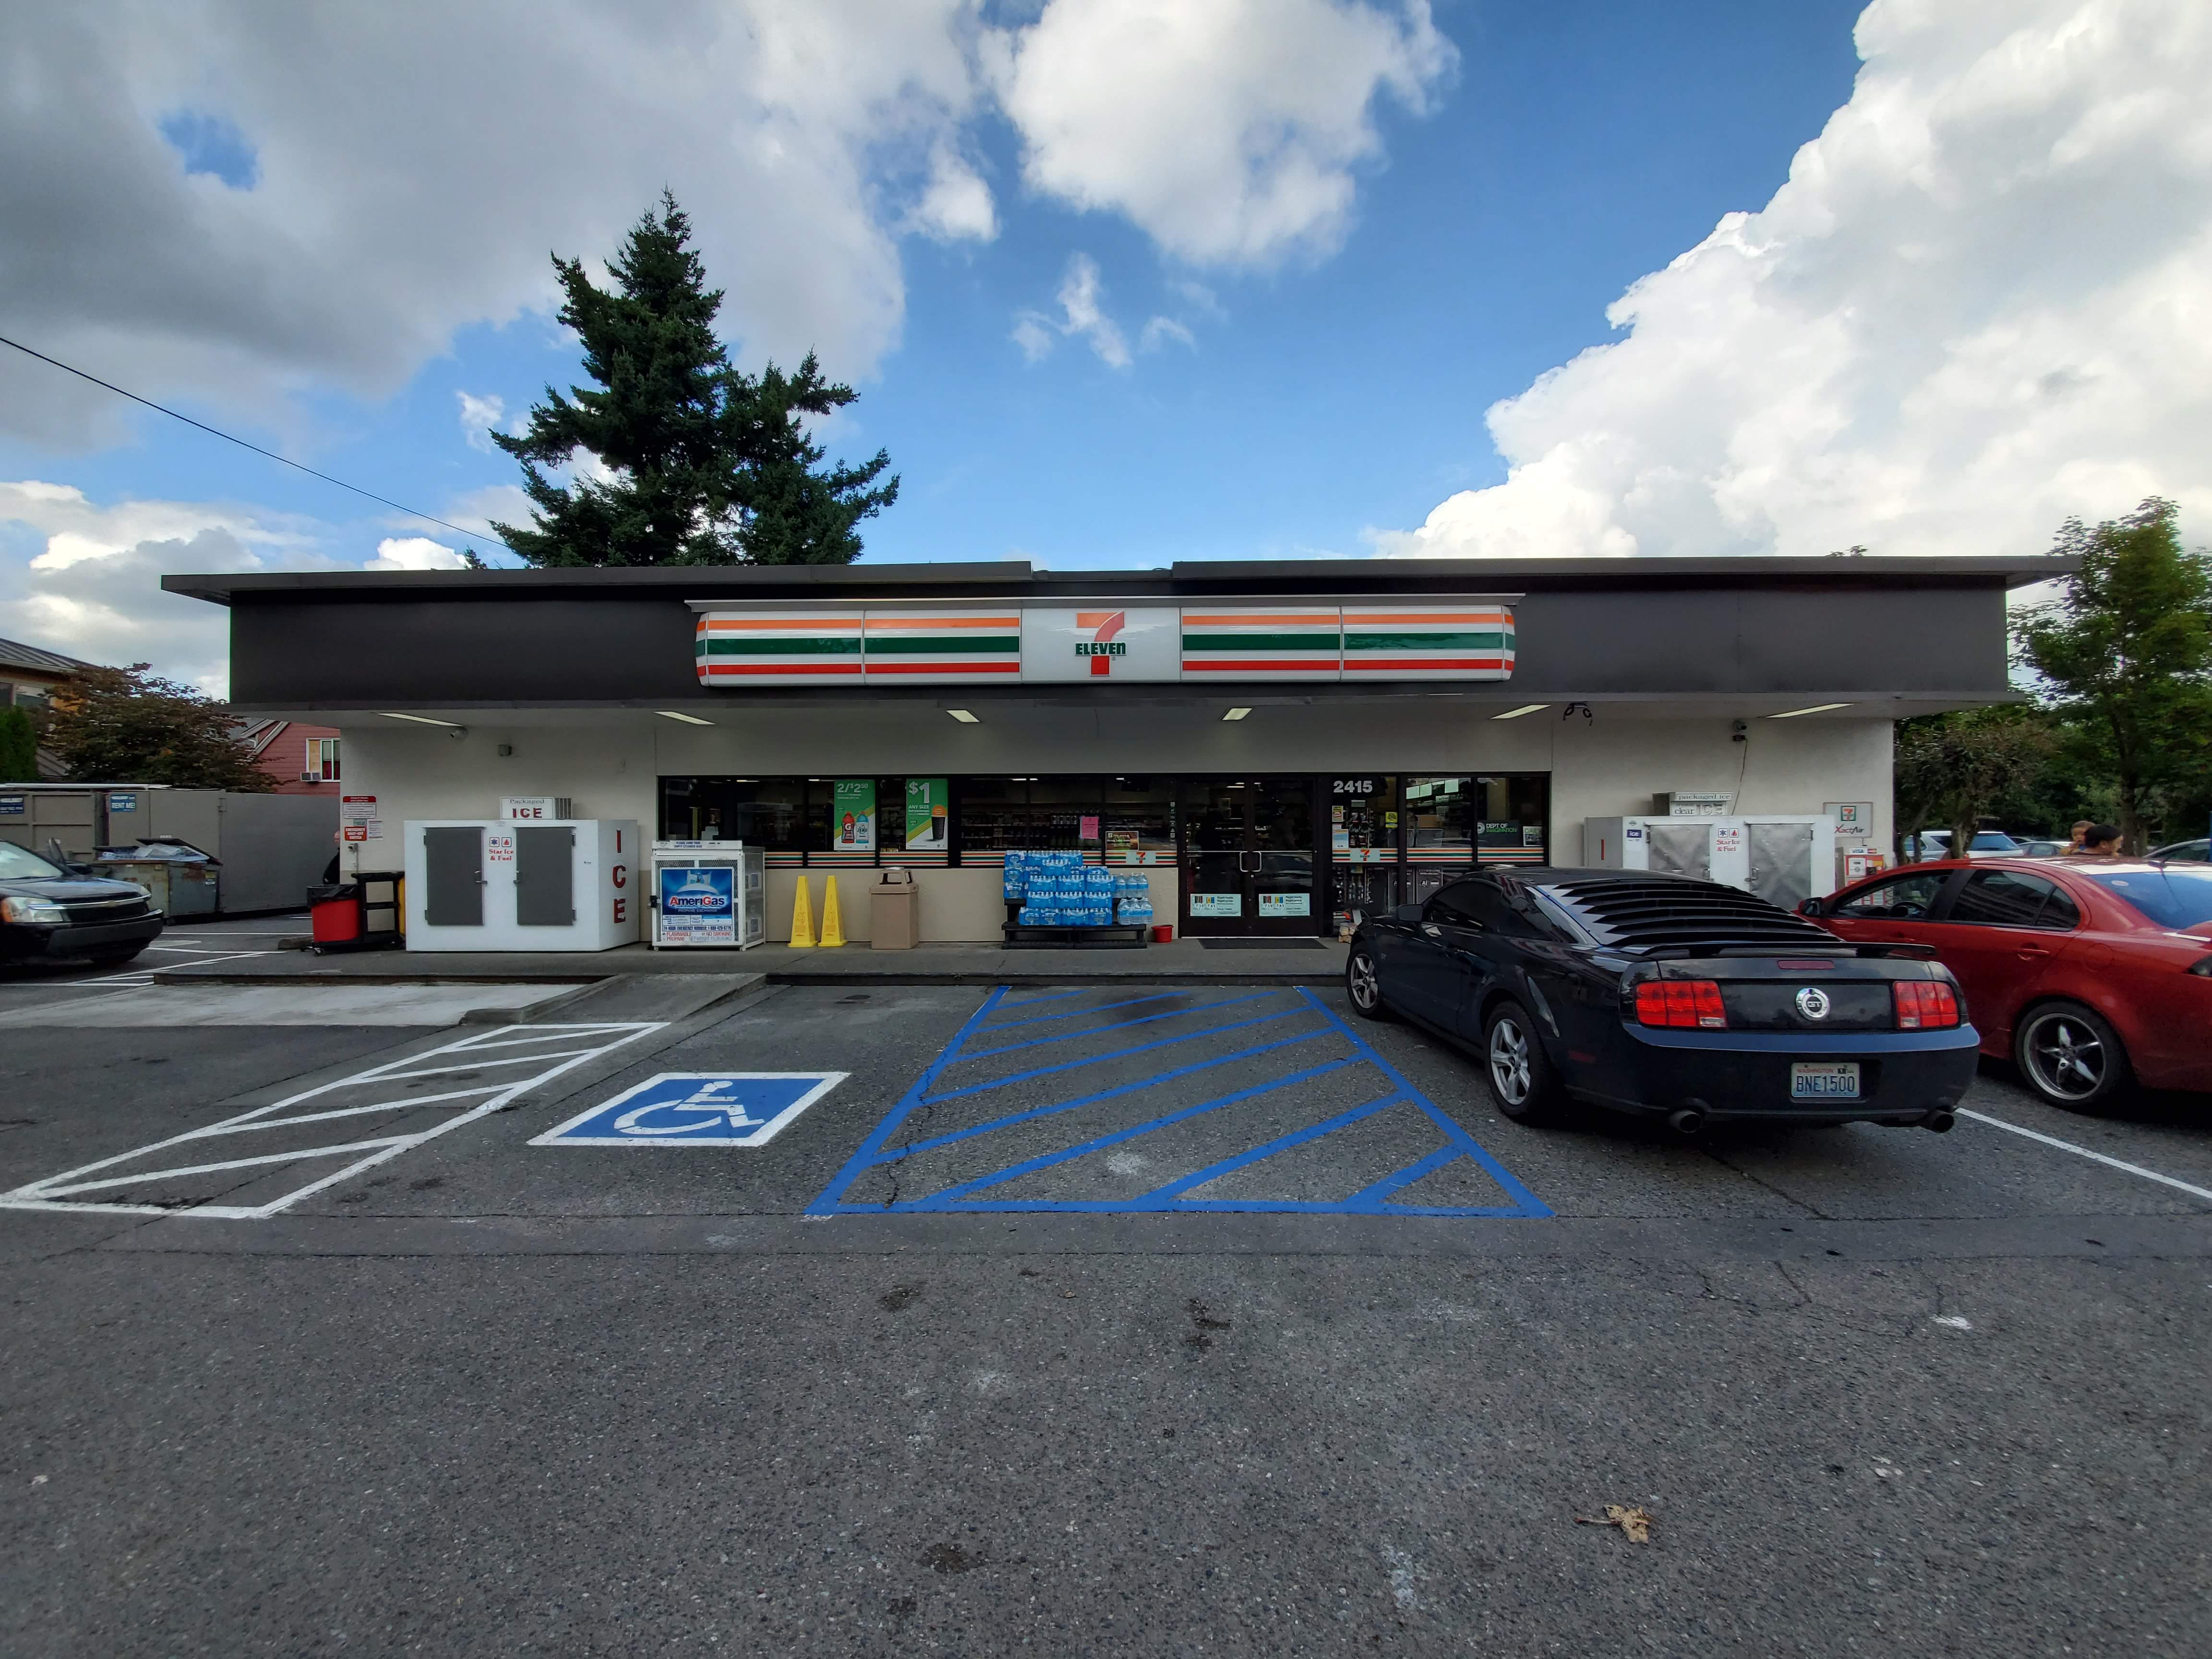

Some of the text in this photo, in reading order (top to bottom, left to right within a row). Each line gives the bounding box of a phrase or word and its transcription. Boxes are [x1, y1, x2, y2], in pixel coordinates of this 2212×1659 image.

[1075, 642, 1126, 655] ELEVEN
[1076, 611, 1124, 675] 7
[909, 781, 929, 803] $1
[1334, 781, 1373, 793] 2415
[512, 808, 542, 818] ICE
[1136, 852, 1145, 864] 7
[1360, 849, 1370, 861] 7
[670, 896, 725, 906] AmeriGas
[1796, 1075, 1855, 1092] BNE1500
